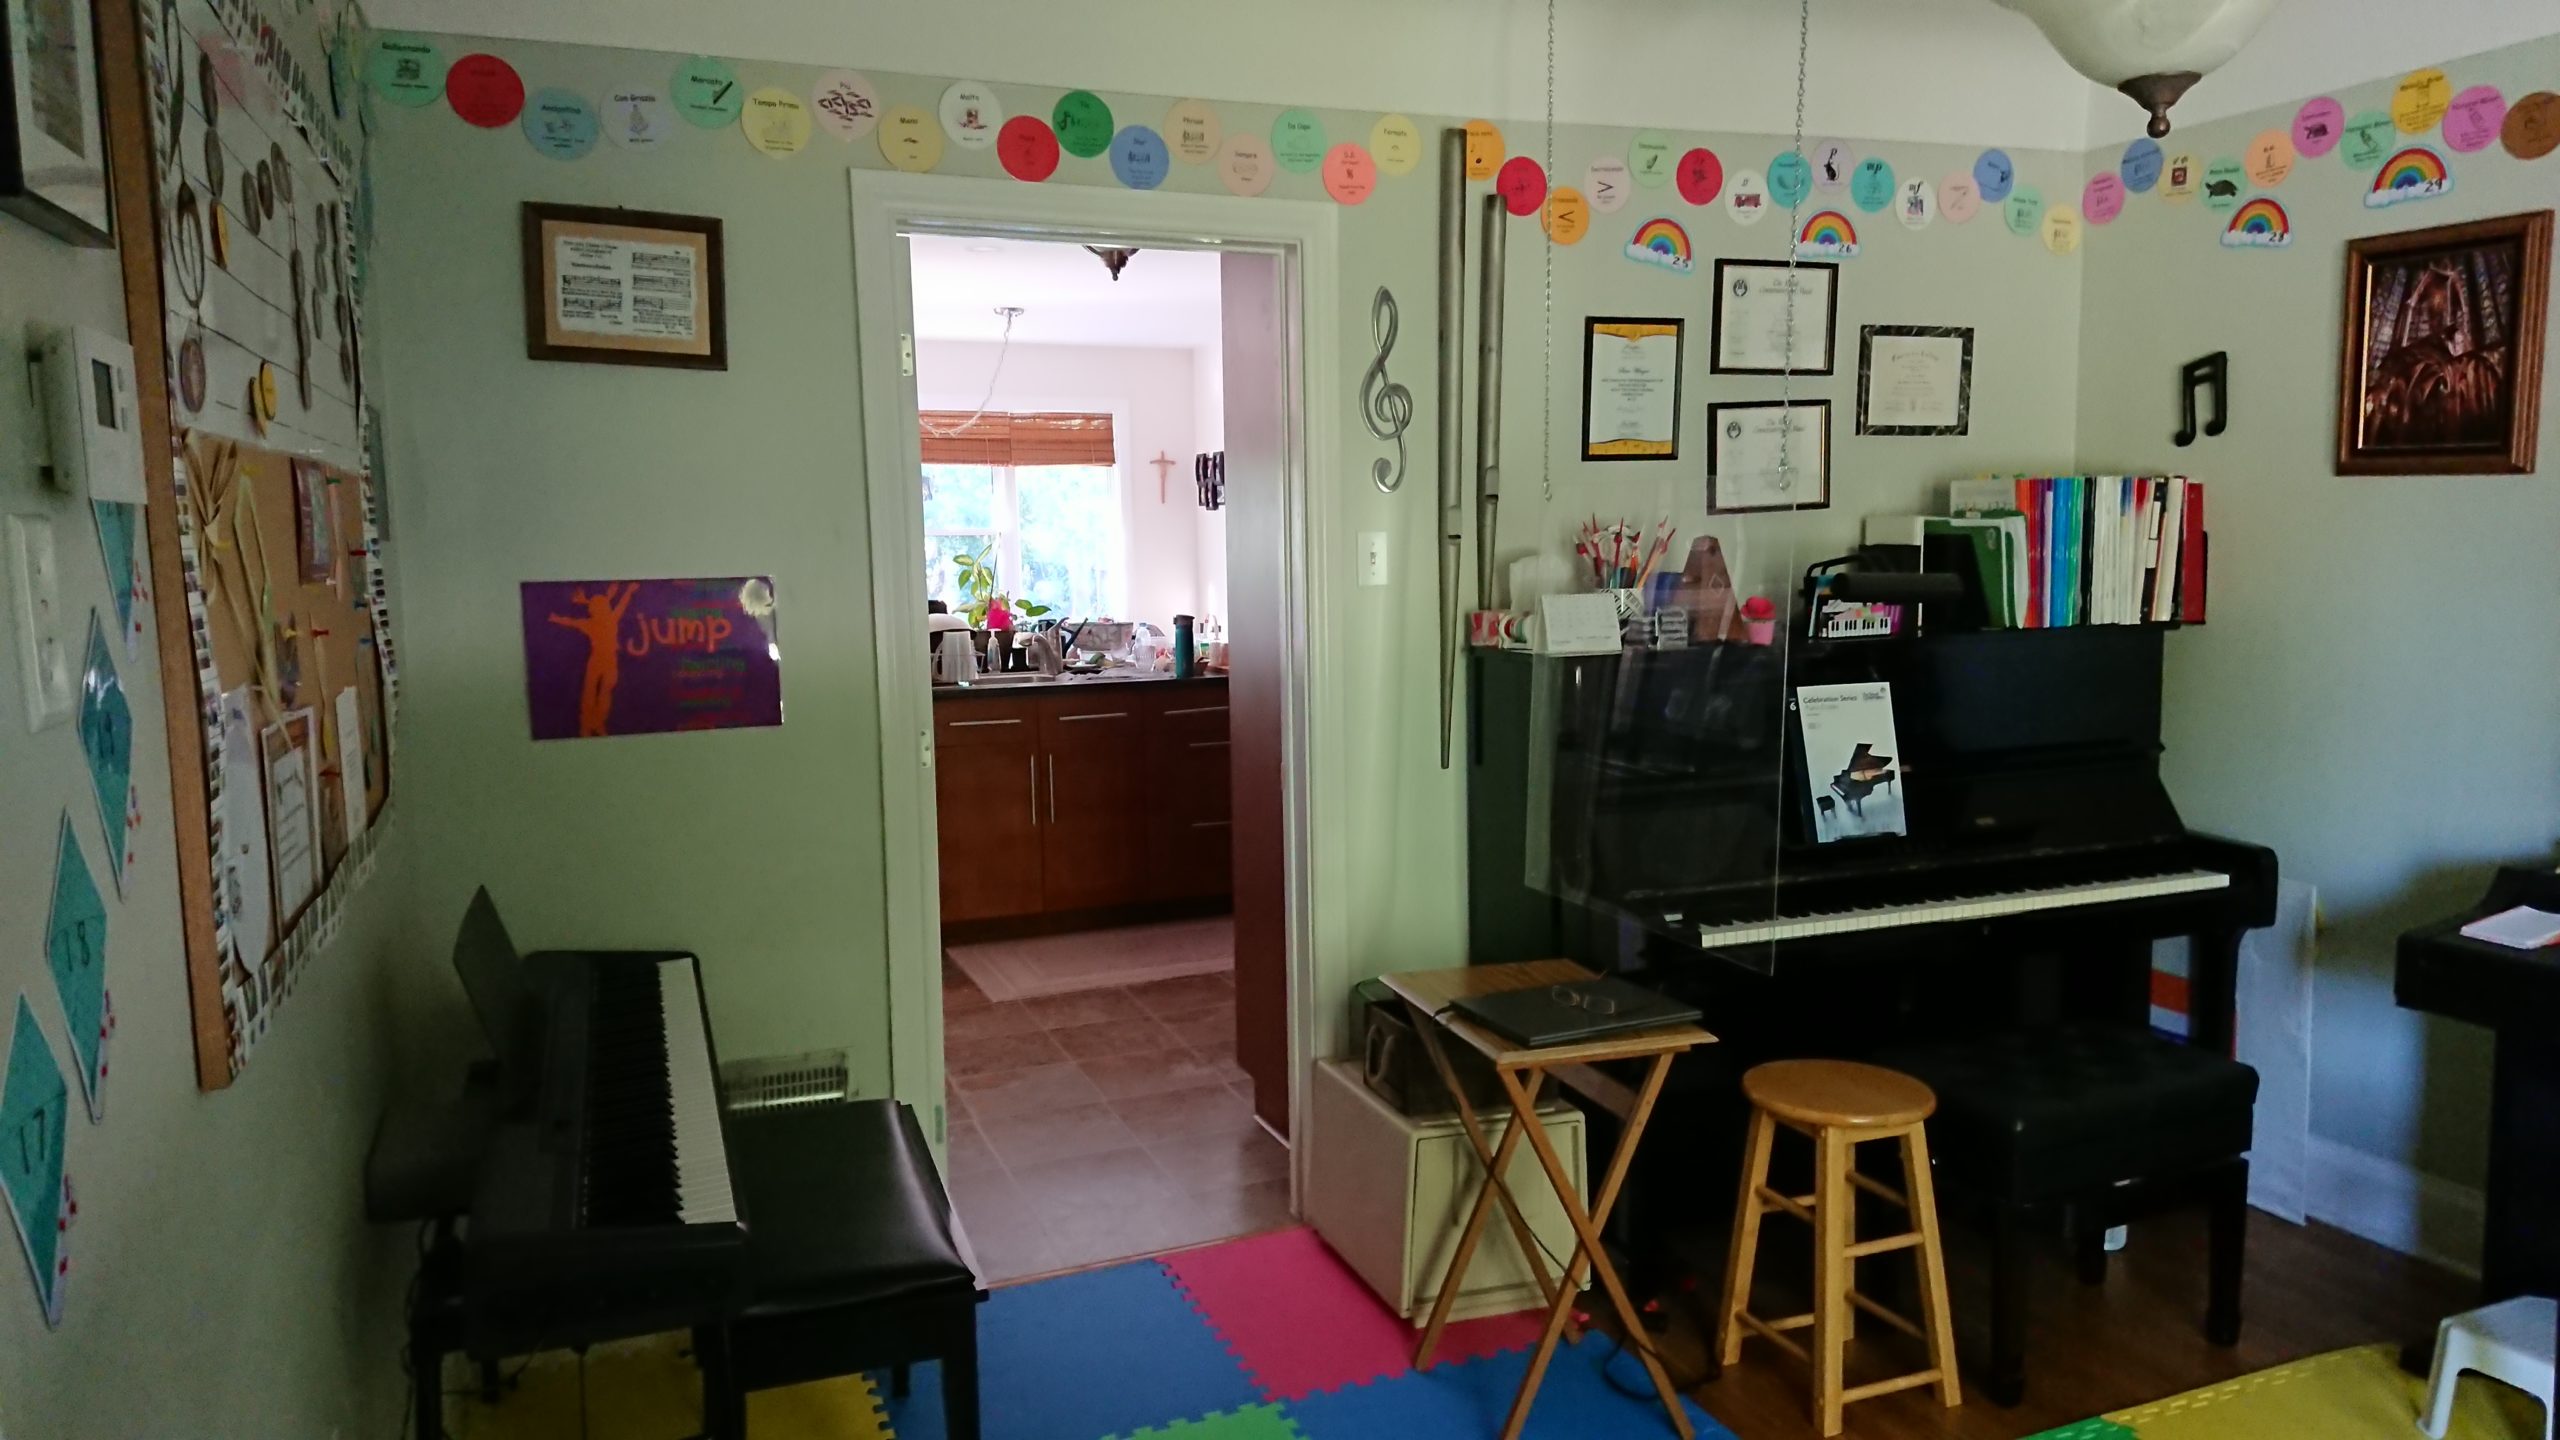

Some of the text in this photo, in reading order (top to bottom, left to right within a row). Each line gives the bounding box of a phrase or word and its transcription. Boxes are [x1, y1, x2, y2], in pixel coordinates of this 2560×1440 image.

[752, 97, 776, 108] Tempo
[1866, 162, 1882, 174] mp
[1909, 180, 1924, 195] mf
[1672, 256, 1689, 269] 25
[627, 613, 733, 657] jump
[1803, 695, 1839, 704] Celebration
[1840, 694, 1857, 702] Series
[59, 920, 91, 973] 18
[20, 1107, 46, 1175] 17
